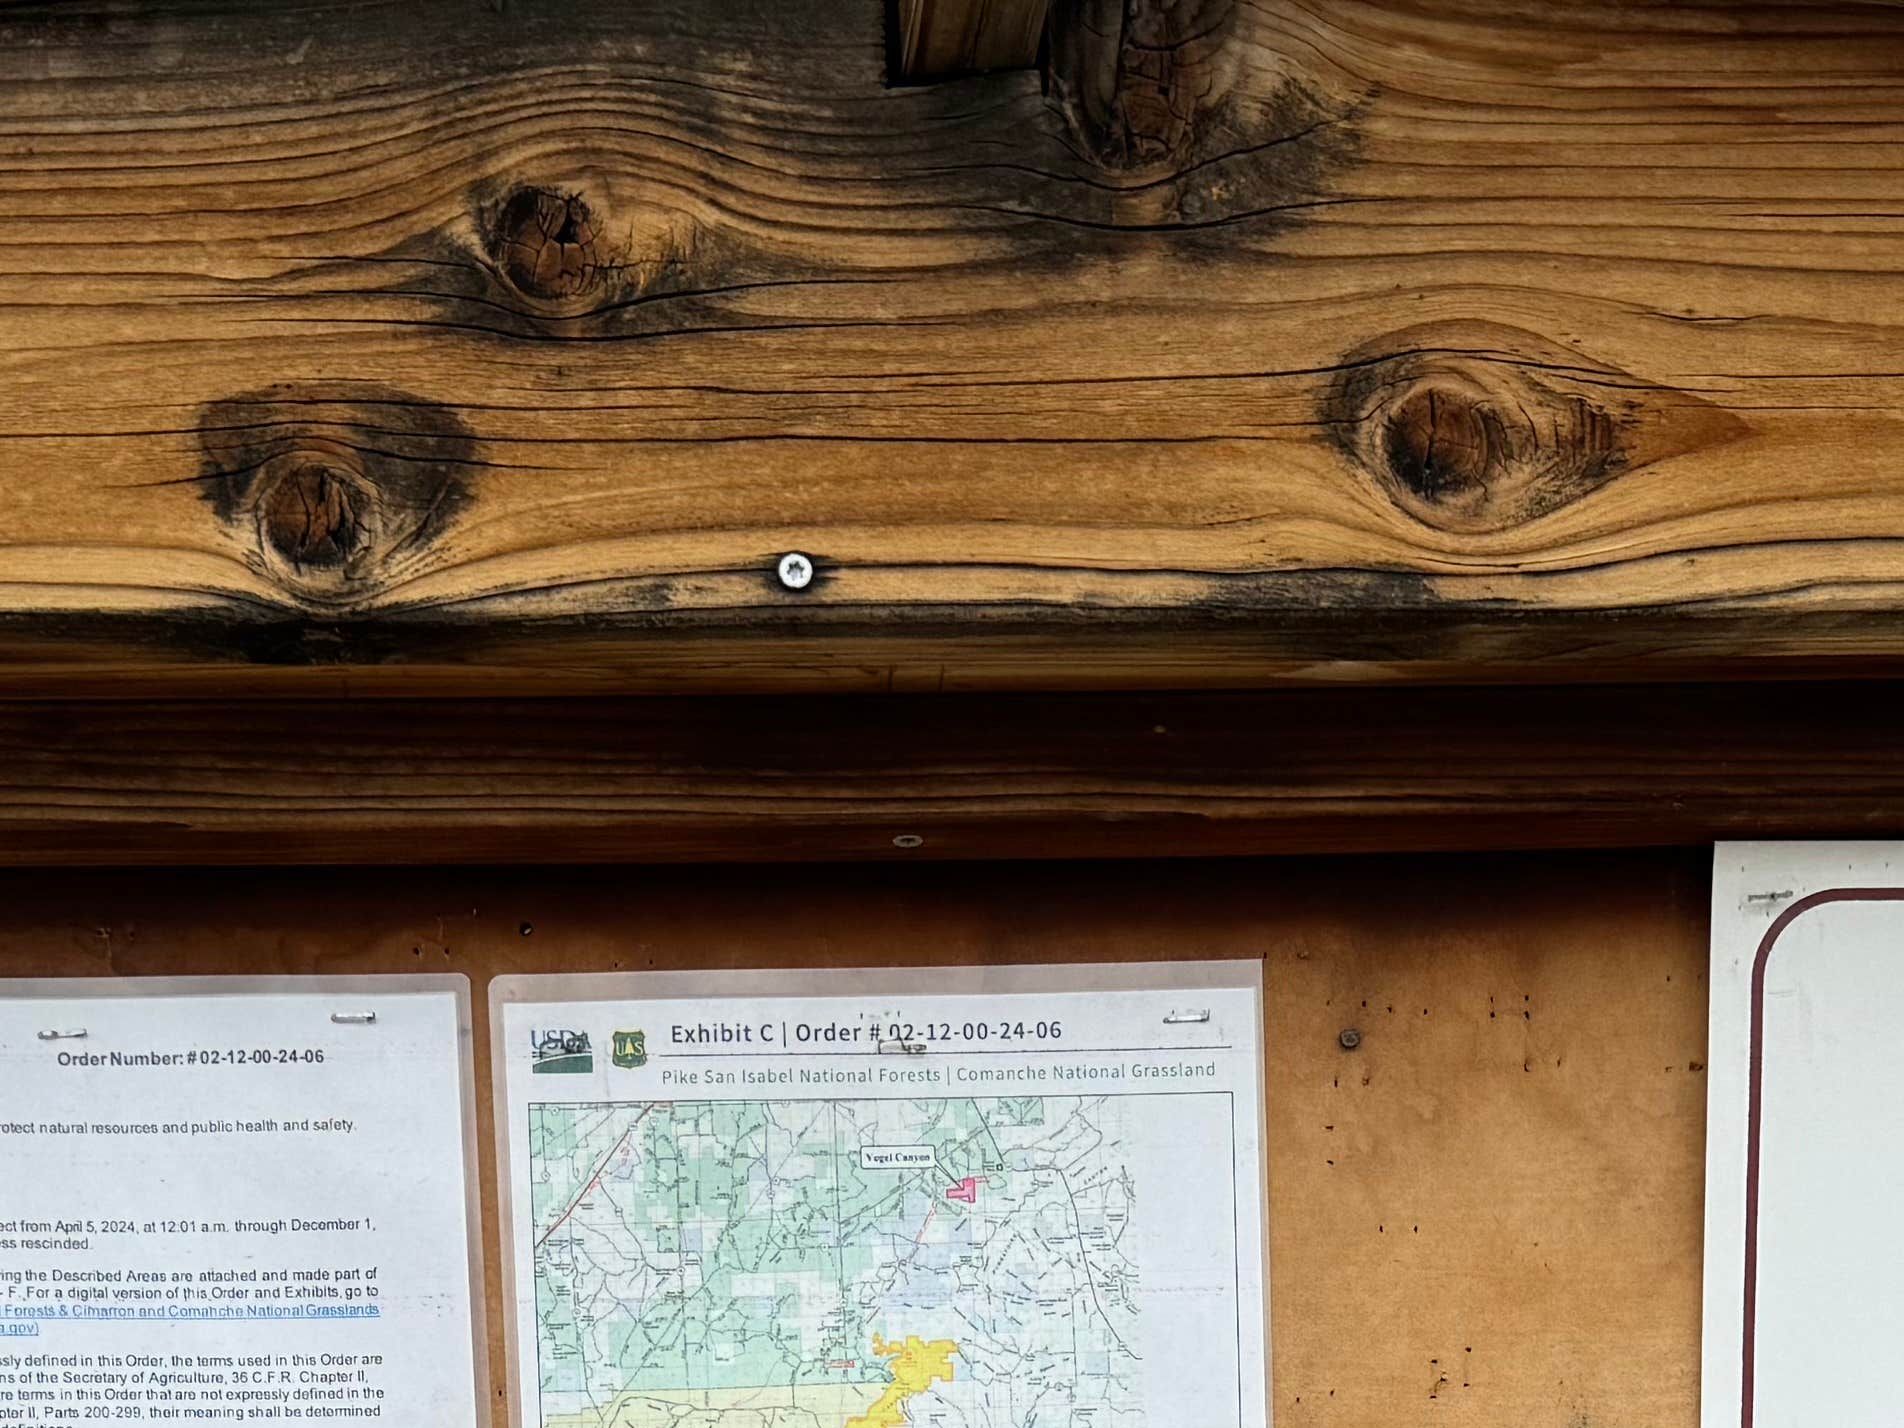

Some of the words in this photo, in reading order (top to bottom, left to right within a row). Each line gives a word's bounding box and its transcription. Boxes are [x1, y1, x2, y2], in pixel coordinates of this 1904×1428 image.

[672, 1022, 753, 1043] Exhibit
[760, 1023, 774, 1042] C
[796, 1021, 863, 1042] Order
[58, 1051, 108, 1066] Order
[110, 1050, 184, 1066] Number:
[663, 1069, 699, 1084] Pike
[705, 1068, 736, 1083] San
[743, 1066, 793, 1083] Isabel
[800, 1066, 873, 1083] National
[880, 1067, 941, 1082] Forests
[957, 1064, 1047, 1081] Comanche
[1053, 1063, 1126, 1080] National
[1132, 1061, 1216, 1078] Grassland
[40, 1121, 89, 1133] natural
[92, 1123, 159, 1134] resources
[162, 1120, 189, 1133] and
[191, 1119, 233, 1136] public
[236, 1118, 279, 1132] health
[283, 1119, 310, 1131] and
[313, 1117, 354, 1133] safety.
[866, 1153, 892, 1163] Vogel
[895, 1152, 930, 1163] Canyon
